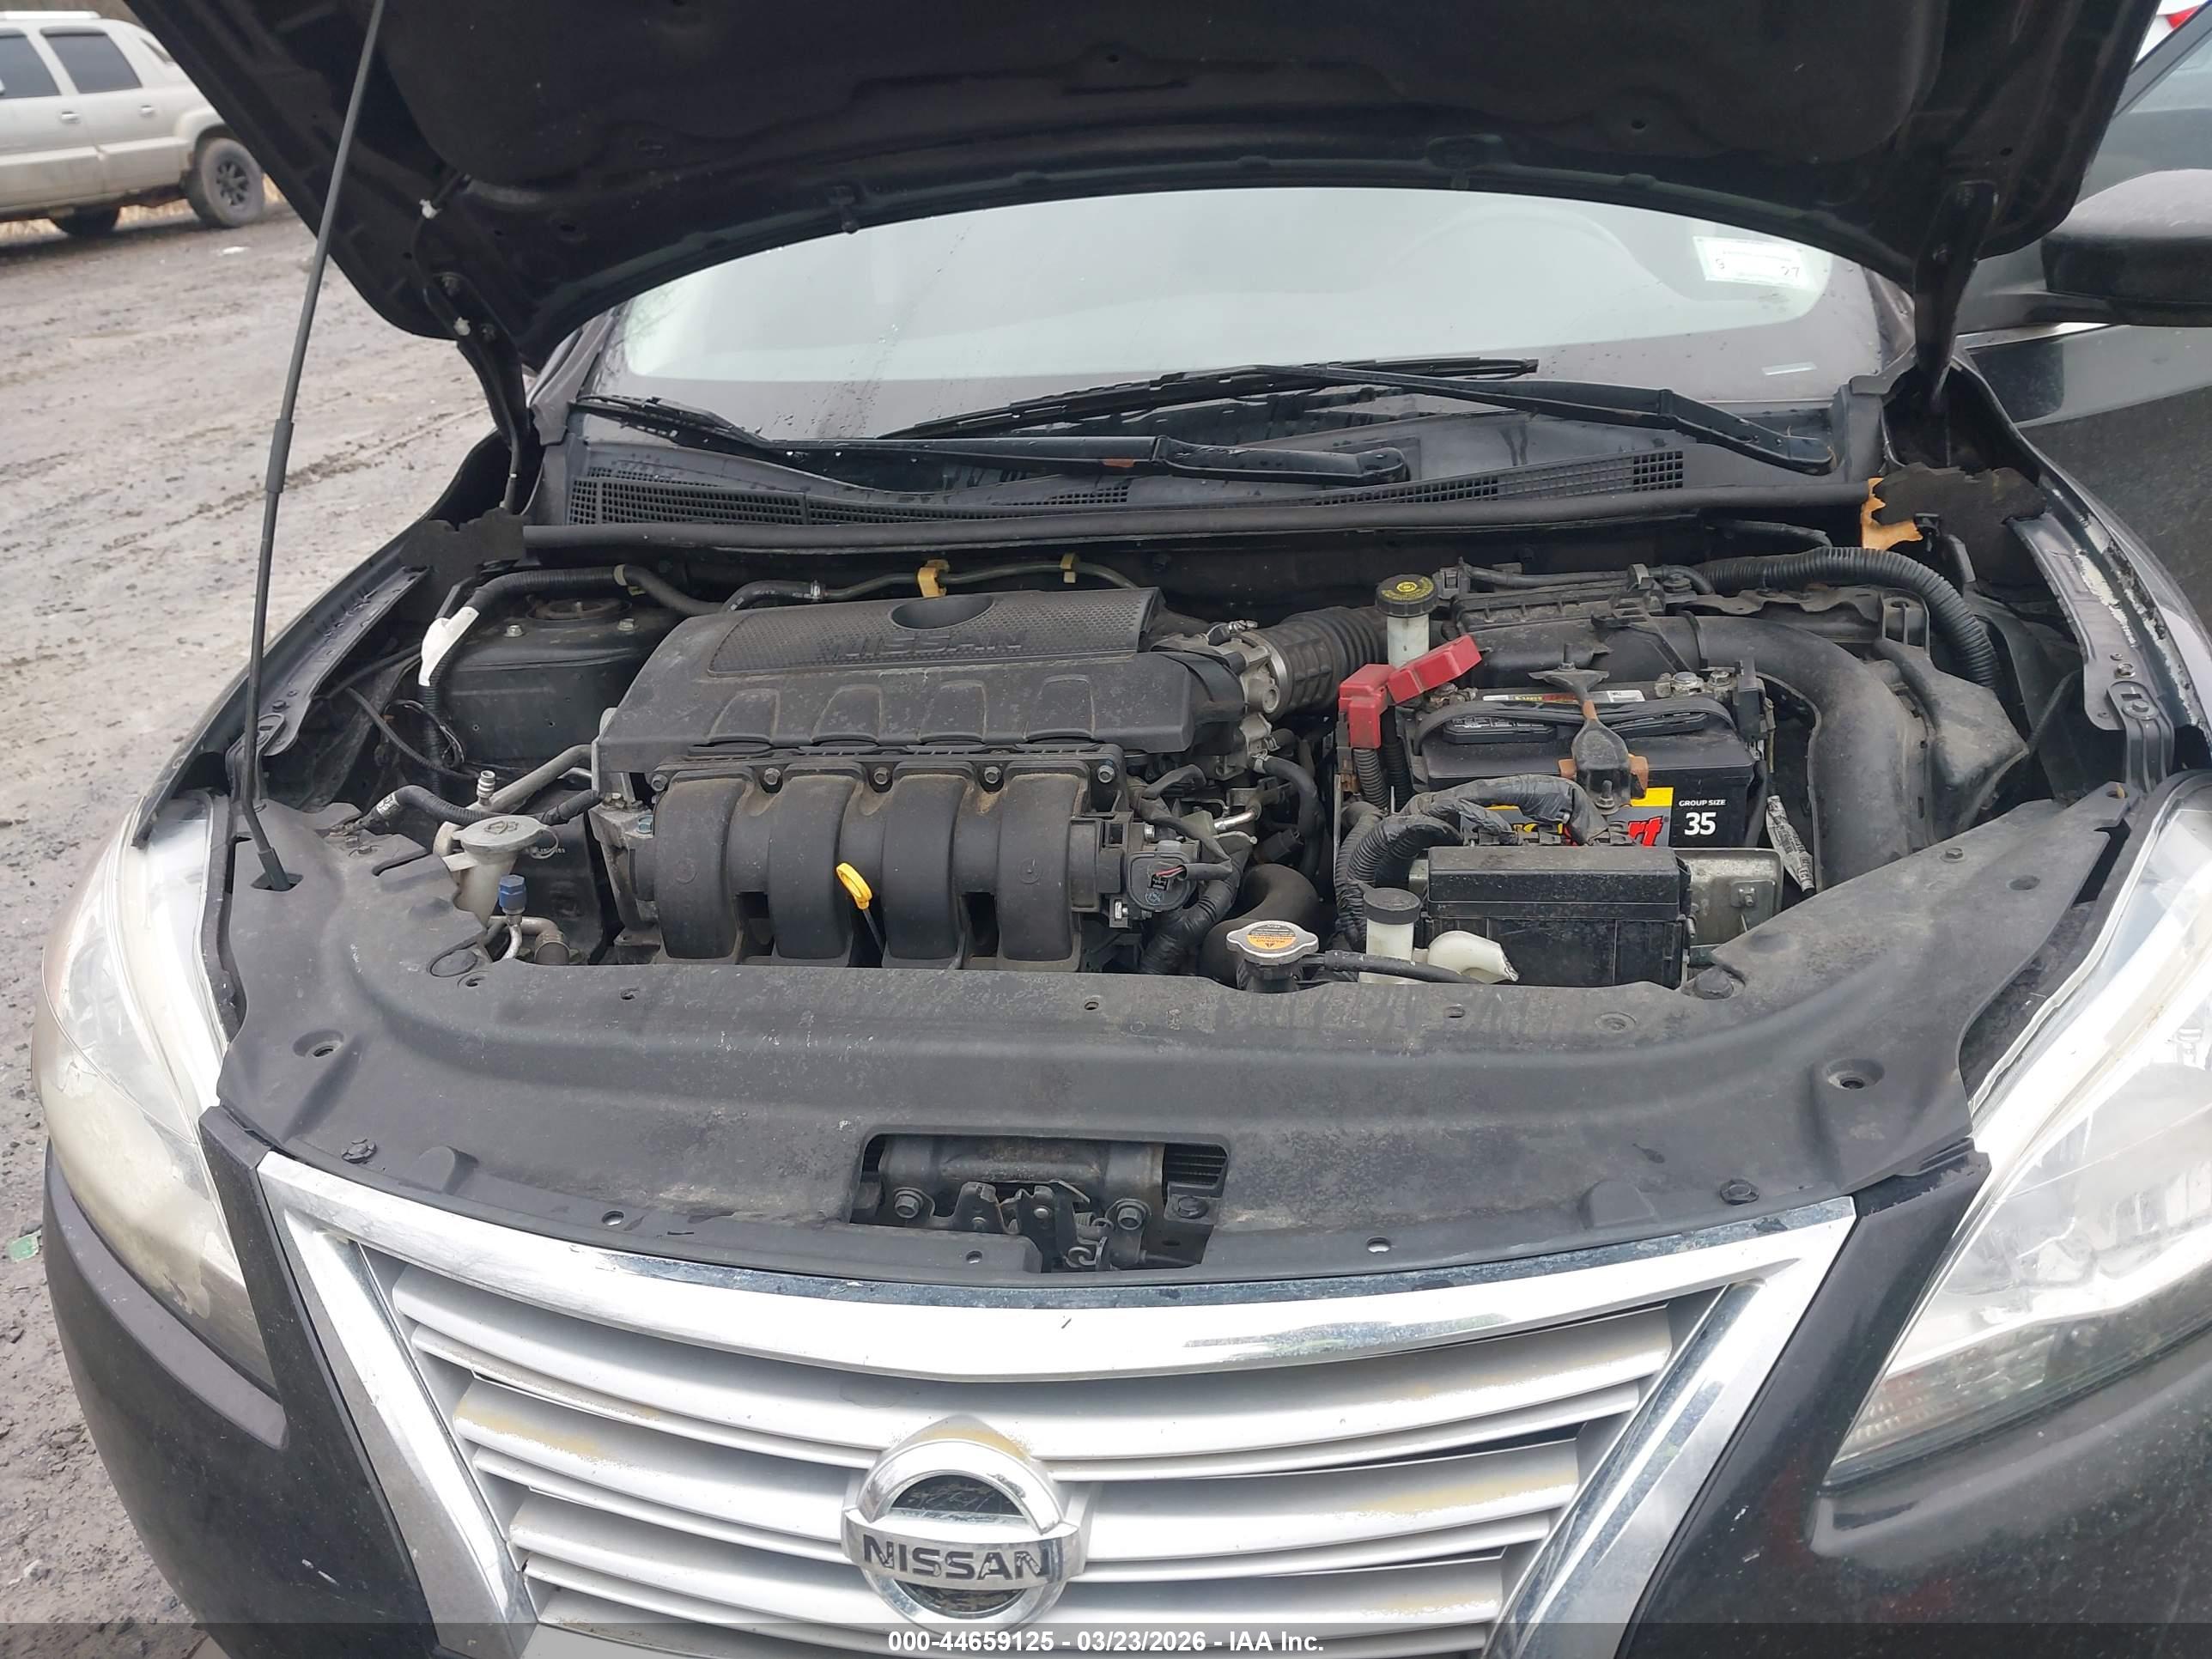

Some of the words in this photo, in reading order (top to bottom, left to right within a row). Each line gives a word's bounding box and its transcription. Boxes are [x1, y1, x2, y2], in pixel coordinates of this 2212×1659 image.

[830, 631, 1028, 659] NISSAN
[1678, 799, 1707, 807] GROUP
[1684, 811, 1717, 836] 35
[863, 1534, 1051, 1581] NISSAN
